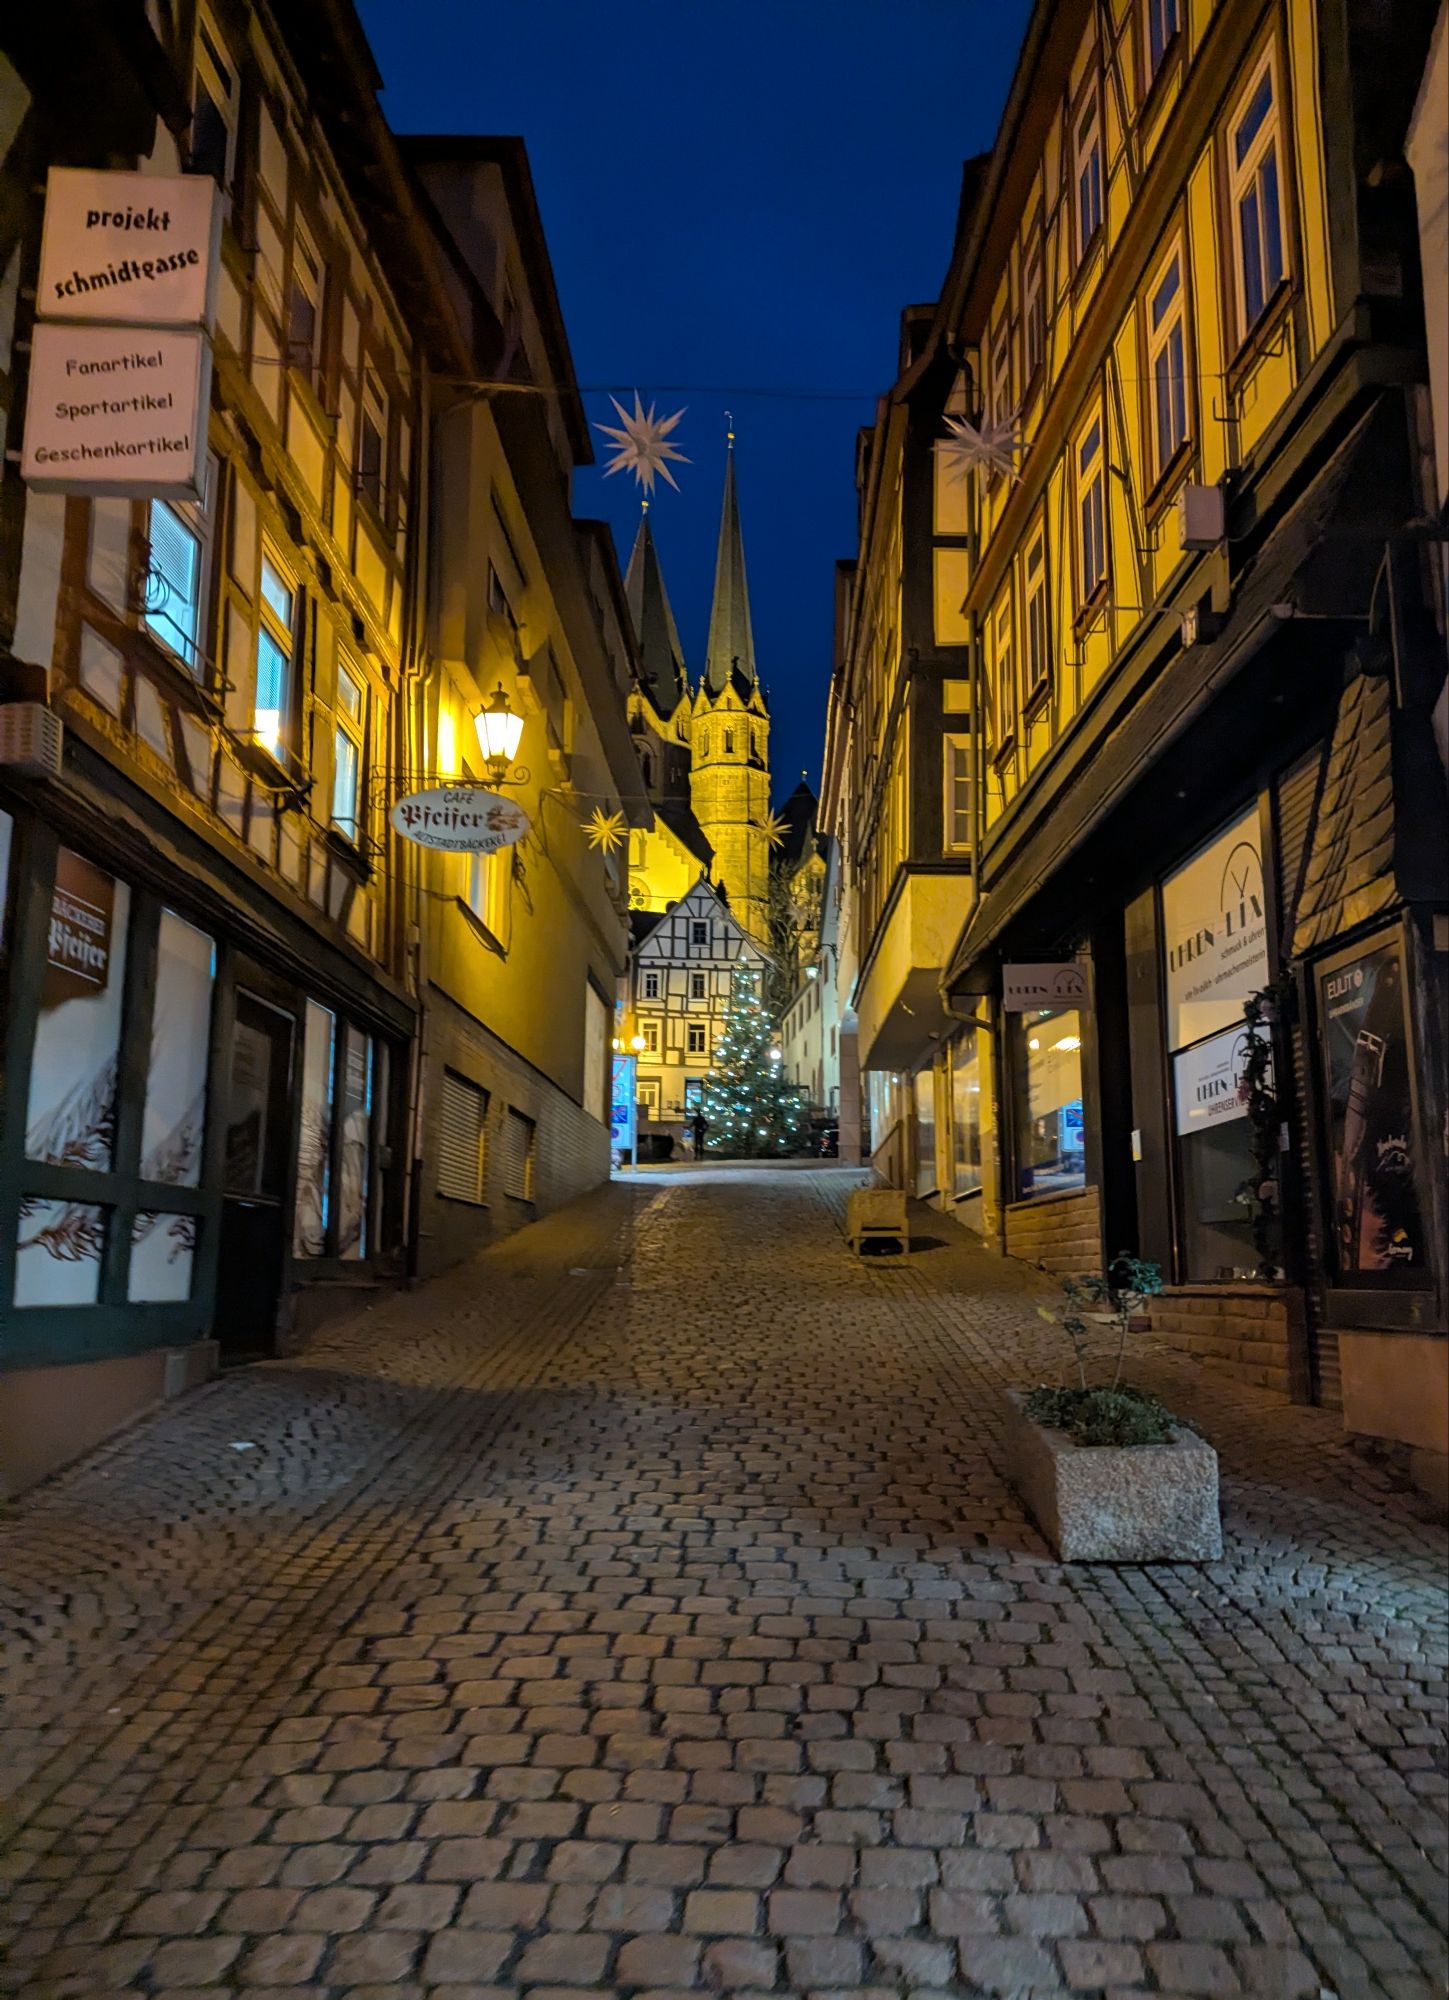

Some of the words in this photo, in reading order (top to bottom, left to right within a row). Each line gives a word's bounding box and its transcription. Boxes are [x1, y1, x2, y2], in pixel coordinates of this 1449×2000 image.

[86, 207, 171, 232] projekt
[54, 248, 200, 300] schmidtgasse
[65, 351, 164, 378] Fanartikel
[55, 393, 173, 423] Sportartikel
[34, 436, 190, 465] Geschenkartikel
[400, 804, 483, 832] Pfeifer
